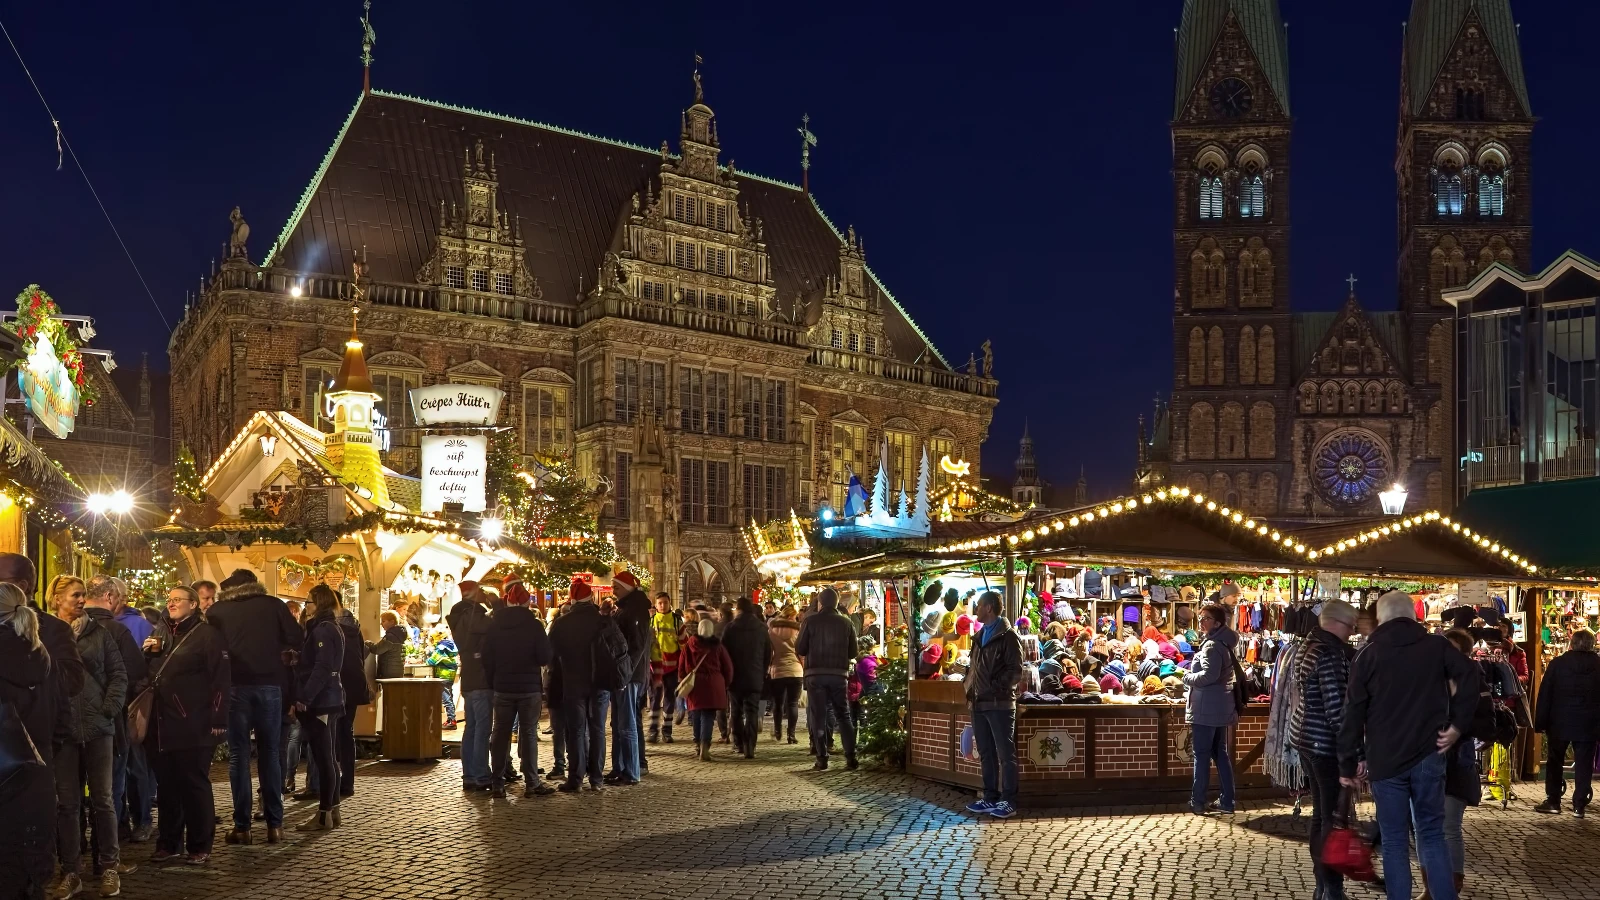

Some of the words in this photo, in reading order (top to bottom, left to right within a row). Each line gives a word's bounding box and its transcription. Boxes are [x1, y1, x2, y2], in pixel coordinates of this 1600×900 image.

[446, 450, 464, 463] süß
[429, 466, 479, 479] beschwipst
[439, 481, 467, 494] deftig
